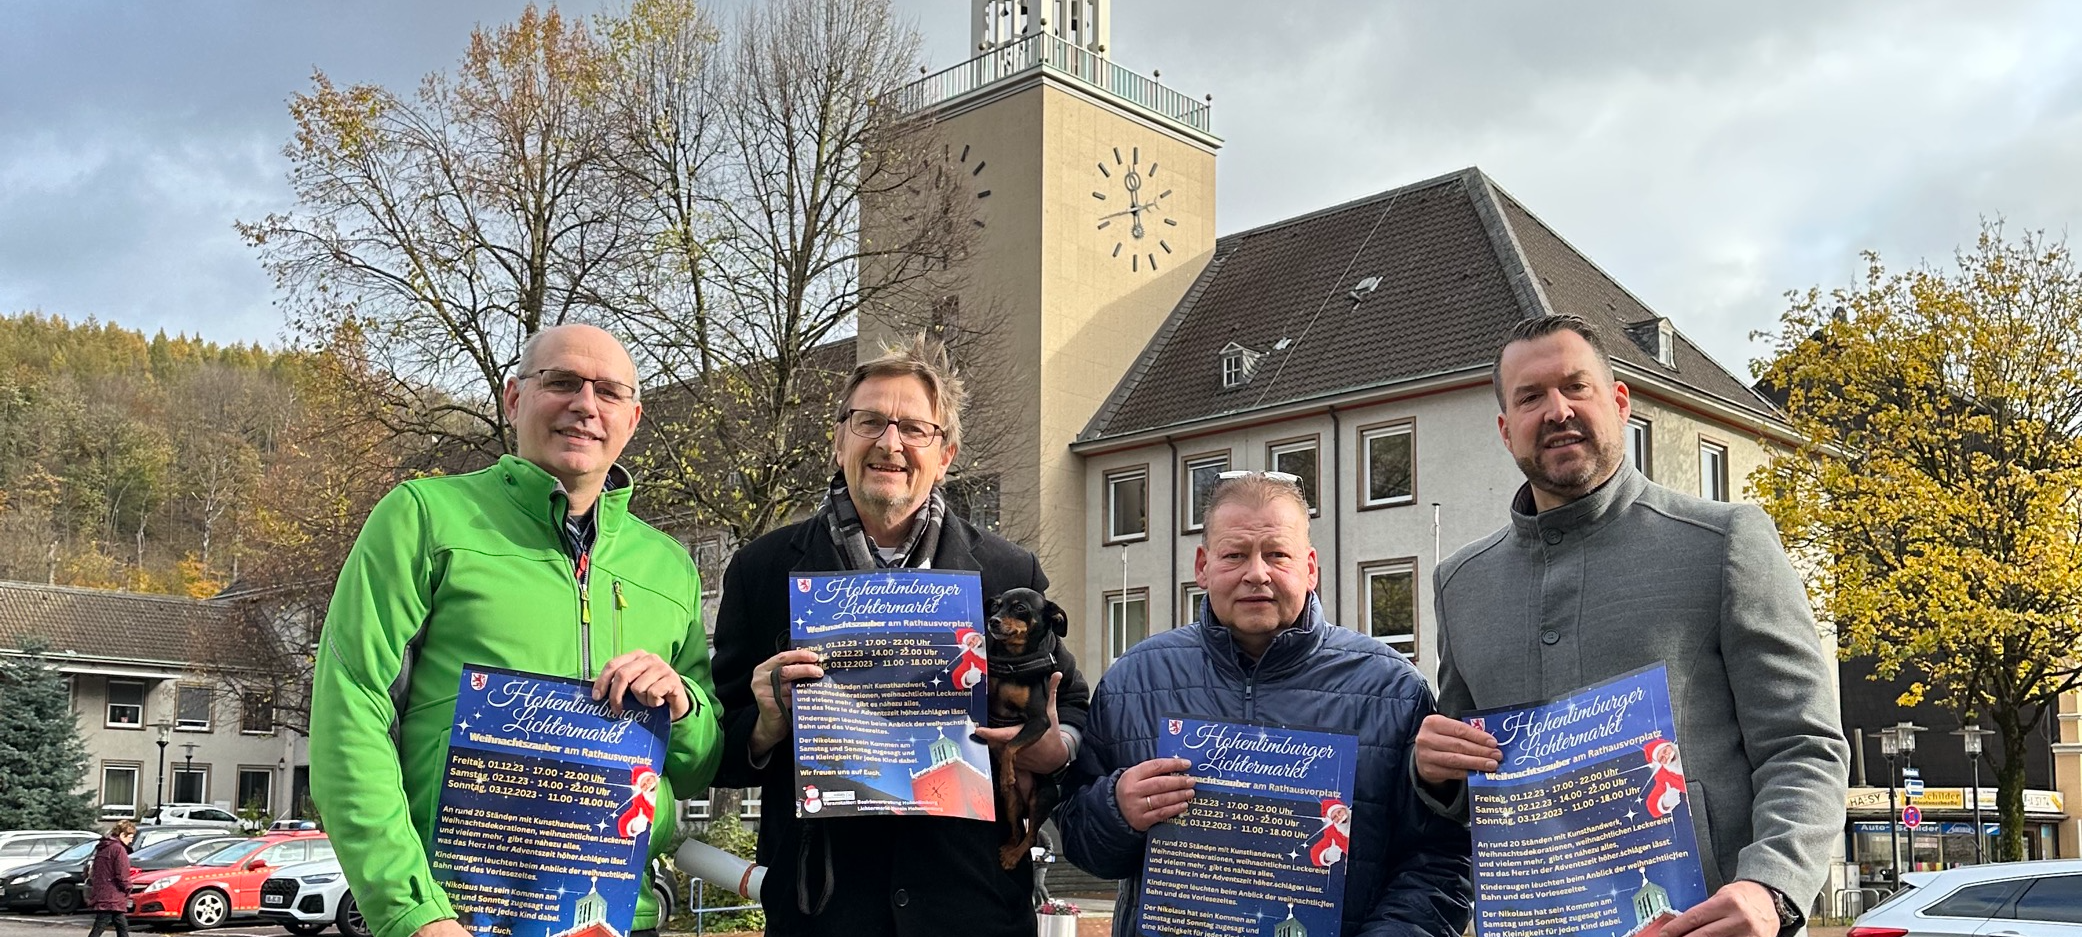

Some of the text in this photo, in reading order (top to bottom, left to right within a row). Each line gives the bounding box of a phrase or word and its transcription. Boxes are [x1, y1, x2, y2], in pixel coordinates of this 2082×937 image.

[814, 577, 962, 603] Hohenlimburger
[832, 594, 939, 621] Lichtermarkt
[806, 620, 886, 633] Weihnachtszauber
[903, 619, 973, 628] Rathausvorplatz
[825, 640, 858, 649] 01.12.23
[831, 649, 864, 658] 02.12.23
[871, 649, 894, 657] 14.00
[923, 648, 939, 656] Uhr
[830, 661, 873, 669] 03.12.2023
[882, 659, 904, 667] 11.00
[910, 658, 933, 666] 18.00
[934, 658, 949, 666] Uhr
[502, 706, 626, 743] Lichtermarkt
[1491, 686, 1646, 746] Hohenlimburger
[469, 732, 653, 766] Weihnachtszauber am Rathausvorplatz
[1183, 723, 1336, 764] Hohenlimburger
[1514, 714, 1623, 766] Lichtermarkt
[1197, 746, 1309, 779] Lichtermarkt
[1485, 730, 1662, 780] Weihnachtszauber am Rathausvorplatz
[449, 767, 611, 796] Samstag, 02.12.23 14.00 22.00 Uhr
[452, 755, 606, 784] Freitag, 01.12.23 17.00 22.00 Uhr
[447, 779, 619, 809] Sonntag, 03.12.2023 11.00 18.00 Uhr
[1268, 782, 1341, 799] Rathausvorplatz
[1474, 768, 1619, 804] Freitag, 01.12.23 17.00 22.00 Uhr
[1475, 777, 1628, 815] Samstag, 02.12.23 14.00 22.00 Uhr
[442, 805, 592, 832] An rund 20 Ständen mit Kunsthandwerk,
[1191, 808, 1224, 819] 02.12.23
[1231, 813, 1254, 822] 14.00
[1260, 815, 1283, 825] 22.00
[1284, 818, 1300, 827] Uhr
[1226, 801, 1249, 811] 17.00
[1254, 804, 1277, 814] 22.00
[1279, 807, 1294, 815] Uhr
[1475, 786, 1641, 826] Sonntag, 03.12.2023 11.00 18.00 Uhr
[441, 815, 538, 836] Weihnachtsdekorationen,
[539, 829, 599, 842] weihnachtlichen
[455, 829, 481, 837] vielem
[482, 832, 504, 842] mehr,
[507, 835, 523, 844] gibt
[1189, 819, 1232, 831] 03.12.2023
[1241, 825, 1264, 834] 11.00
[1269, 828, 1293, 837] 18.00
[1294, 831, 1310, 839] Uhr
[1477, 841, 1488, 849] An
[1521, 837, 1553, 847] Ständen
[1553, 833, 1566, 841] mit
[1567, 818, 1622, 838] Kunsthandwerk,
[1478, 842, 1575, 858] Weihnachtsdekorationen,
[1575, 826, 1632, 846] weihnachtlichen
[434, 850, 483, 864] Kinderaugen
[484, 856, 518, 867] leuchten
[519, 861, 538, 870] beim
[539, 864, 568, 873] Anblick
[568, 867, 581, 875] der
[1150, 847, 1235, 864] Weihnachtsdekorationen,
[1235, 858, 1291, 870] weihnachtlichen
[1188, 842, 1217, 852] Ständen
[1230, 847, 1284, 860] Kunsthandwerk,
[1478, 860, 1494, 868] und
[1495, 859, 1522, 867] vielem
[1523, 857, 1546, 865] mehr,
[1548, 854, 1563, 864] gibt
[1574, 846, 1600, 857] nahezu
[1600, 841, 1619, 852] alles,
[432, 861, 453, 870] Bahn
[453, 864, 469, 872] und
[470, 866, 485, 874] des
[1480, 882, 1530, 891] Kinderaugen
[1531, 878, 1565, 889] leuchten
[1566, 873, 1585, 884] beim
[1585, 867, 1613, 880] Anblick
[1614, 864, 1627, 874] der
[1481, 893, 1501, 901] Bahn
[1503, 892, 1518, 900] und
[1520, 891, 1534, 899] des
